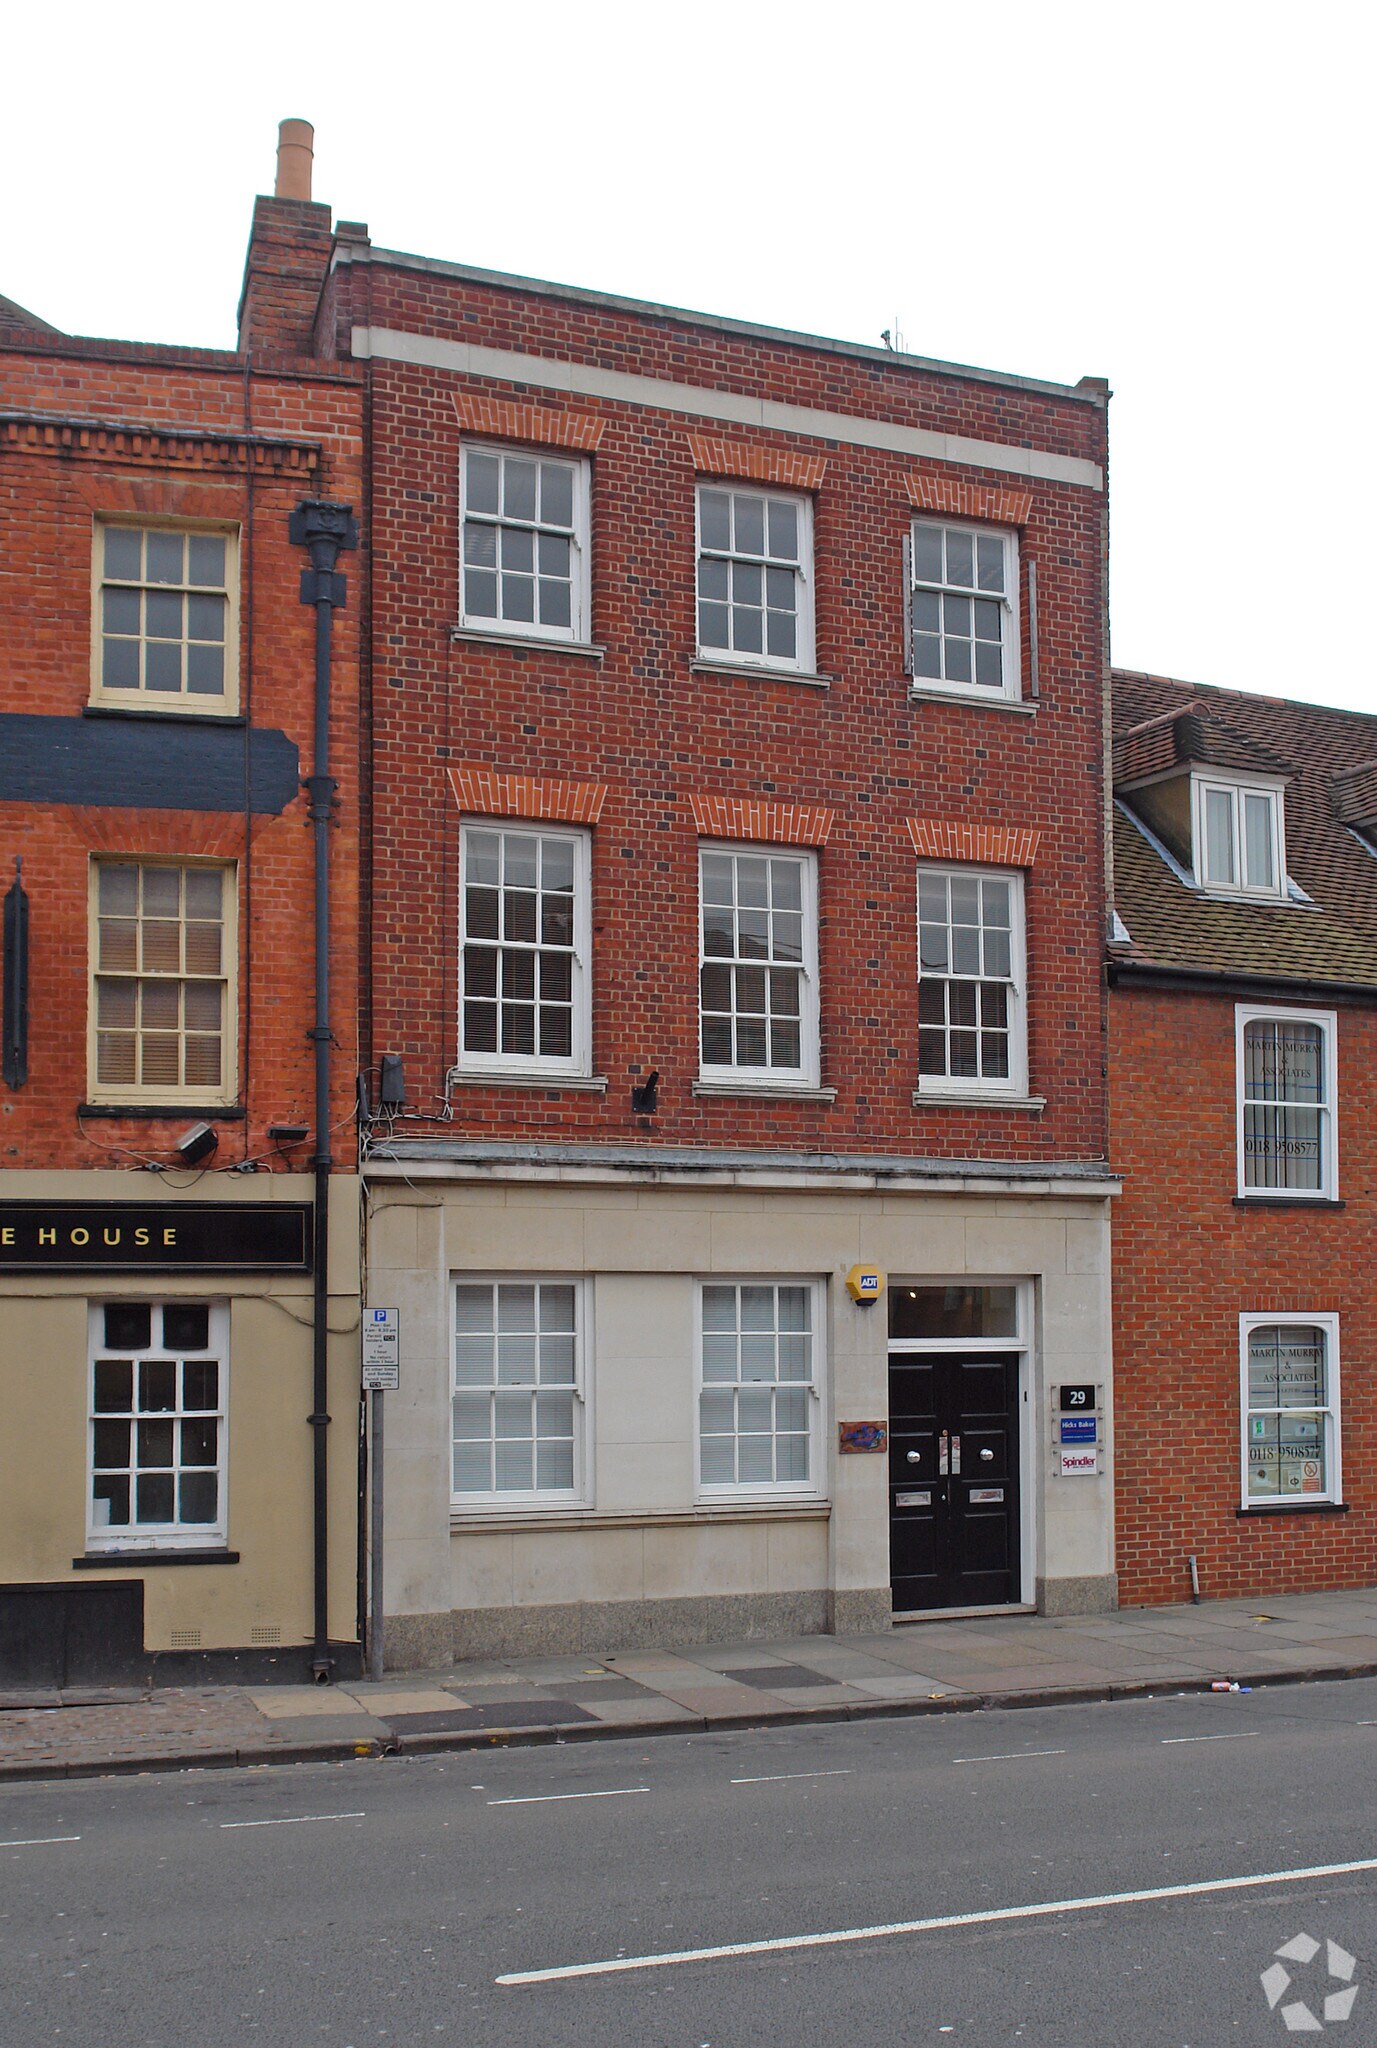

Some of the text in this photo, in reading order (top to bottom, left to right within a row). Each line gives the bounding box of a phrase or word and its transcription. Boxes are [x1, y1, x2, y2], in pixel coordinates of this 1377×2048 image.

[1247, 1041, 1321, 1054] MARTIN MURRAY
[1260, 1066, 1311, 1078] ASSOCIATES
[1246, 1139, 1317, 1155] 0118 9508577
[38, 1227, 178, 1246] HOUSE
[861, 1277, 878, 1287] ADT
[377, 1311, 385, 1321] P
[1250, 1348, 1324, 1358] MARTIN MURRAY
[1284, 1361, 1292, 1370] &
[1264, 1373, 1314, 1383] ASSOCIATES
[1070, 1391, 1086, 1405] 29
[1249, 1446, 1321, 1460] 0118 9508577
[1062, 1456, 1096, 1468] Spindler
